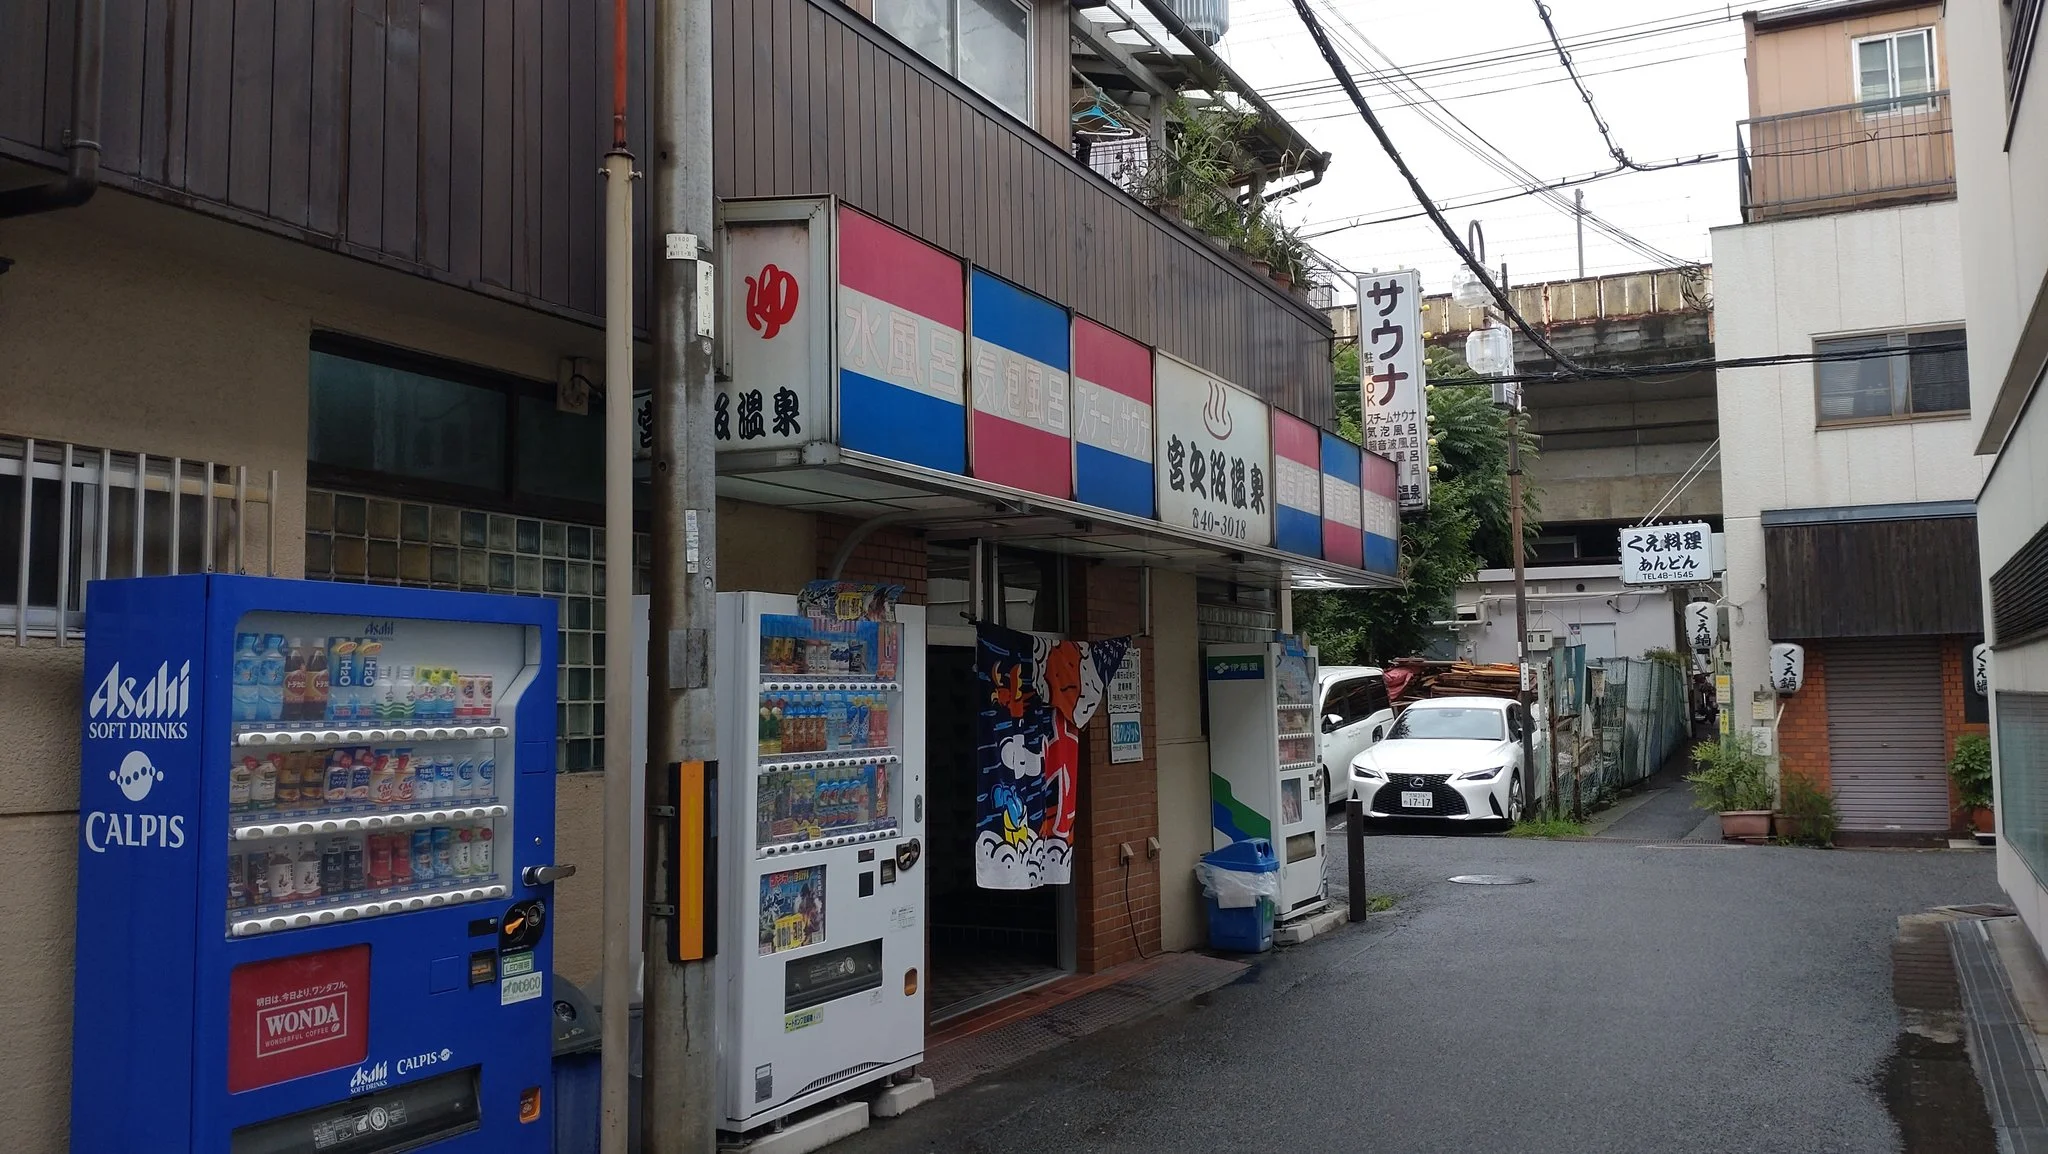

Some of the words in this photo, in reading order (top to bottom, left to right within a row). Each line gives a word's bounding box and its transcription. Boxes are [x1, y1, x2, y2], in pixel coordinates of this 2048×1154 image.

[744, 263, 799, 340] ゆ
[843, 299, 961, 397] 水風呂
[1366, 279, 1409, 406] サウナ
[976, 344, 1066, 430] 気泡風呂
[1078, 385, 1151, 456] スチームサウナ
[1367, 409, 1417, 425] スチームサウナ
[1627, 530, 1703, 553] くえ料理
[1638, 554, 1699, 572] あんどん
[1694, 605, 1712, 647] くえ鍋
[89, 659, 190, 719] Asahi
[1779, 648, 1797, 691] くえ鍋
[88, 722, 126, 739] SOFT
[129, 722, 188, 740] DRINKS
[85, 811, 185, 853] CALPIS
[265, 1001, 340, 1037] WONDA
[265, 1033, 304, 1048] WONDERFUL
[305, 1026, 329, 1038] COFFEE
[350, 1060, 388, 1088] Asahi
[396, 1051, 437, 1075] CALPIS
